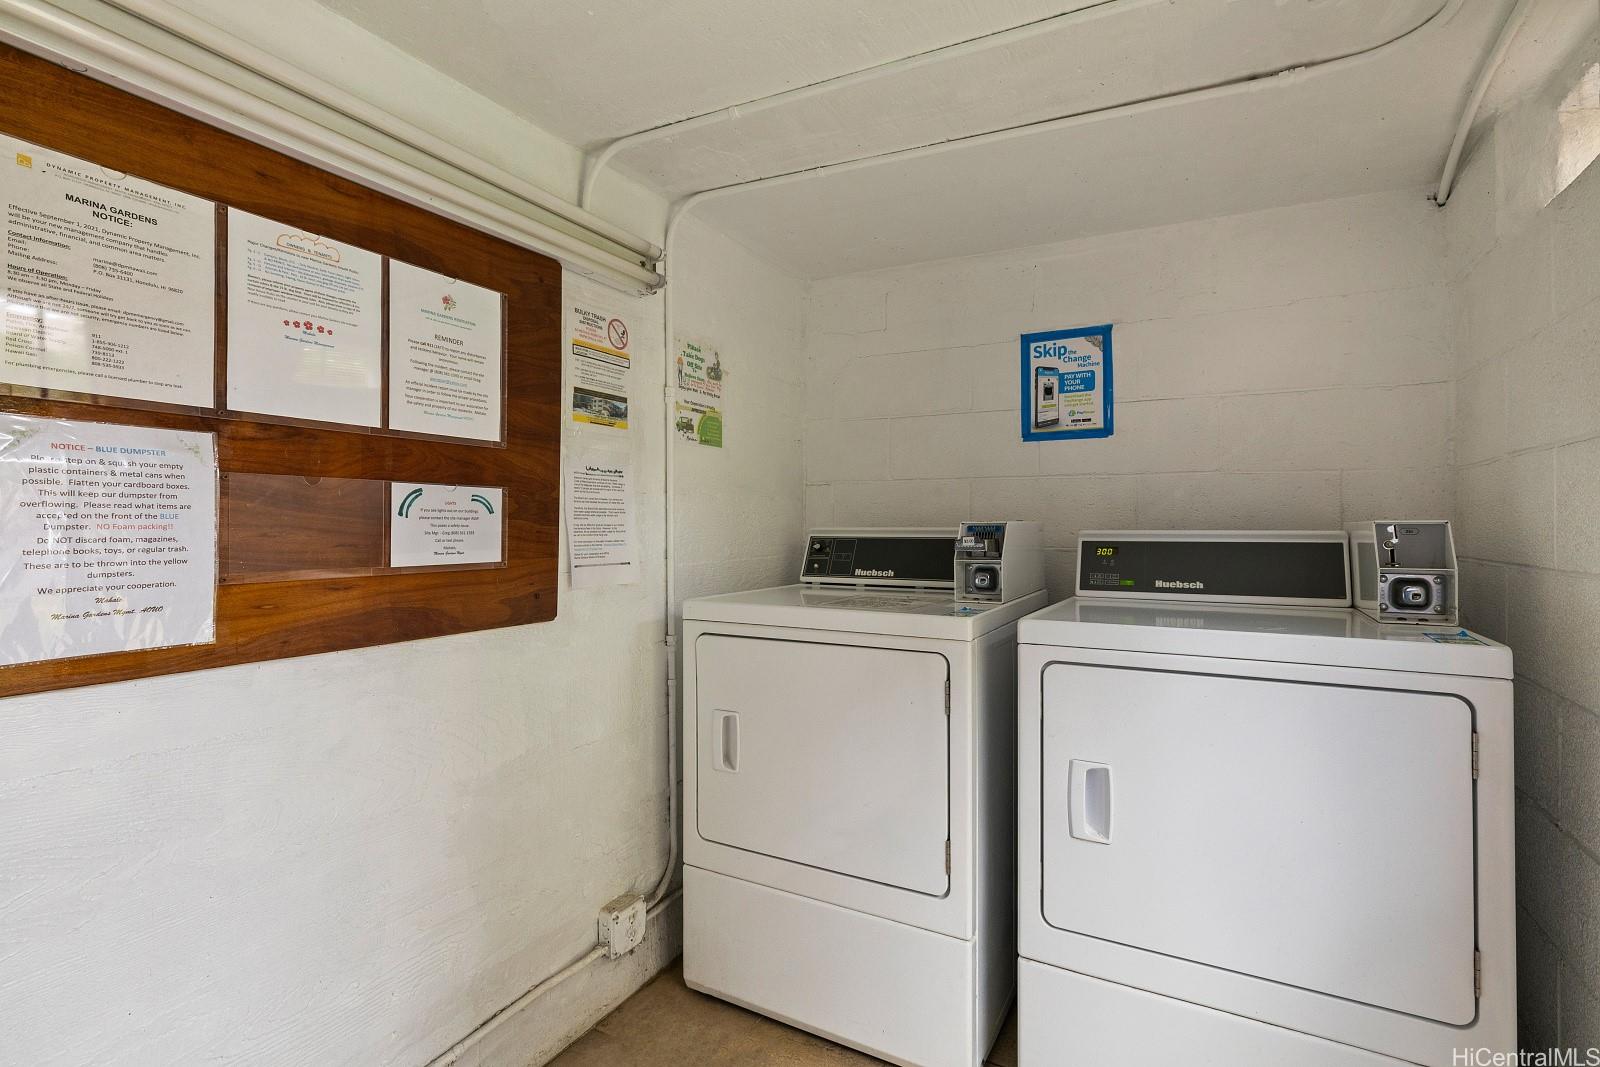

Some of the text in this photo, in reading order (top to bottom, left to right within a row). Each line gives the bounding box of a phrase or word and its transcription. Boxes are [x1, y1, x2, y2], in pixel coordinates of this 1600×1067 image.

[65, 194, 158, 226] MARINA GARDENS
[92, 212, 133, 228] NOTICE:
[8, 204, 37, 217] Effective
[40, 212, 75, 227] September
[102, 228, 127, 241] Dynamic
[129, 236, 153, 249] Property
[8, 230, 32, 240] Contact
[32, 218, 47, 226] your
[64, 227, 104, 241] management
[106, 237, 131, 250] company
[132, 244, 145, 252] that
[8, 243, 30, 253] Phone:
[101, 243, 128, 254] common
[8, 250, 30, 261] Mailing
[8, 264, 25, 272] Hours
[575, 307, 590, 316] BULKY
[435, 334, 463, 345] REMINDER
[1033, 342, 1067, 360] Skip
[1063, 354, 1091, 363] Change
[51, 443, 86, 452] NOTICE
[95, 446, 118, 454] BLUE
[120, 448, 166, 457] DUMPSTER
[28, 467, 59, 476] plastic
[159, 463, 184, 472] empty
[68, 479, 100, 487] Flatten
[78, 491, 99, 500] keep
[118, 492, 158, 501] dumpster
[20, 501, 78, 510] overflowing.
[43, 524, 91, 532] Dumpster.
[137, 546, 166, 555] regular
[163, 558, 187, 567] yellow
[854, 568, 894, 577] Huebsch
[55, 586, 103, 596] appreciate
[127, 583, 176, 592] cooperation.
[1155, 580, 1204, 589] Huebsch
